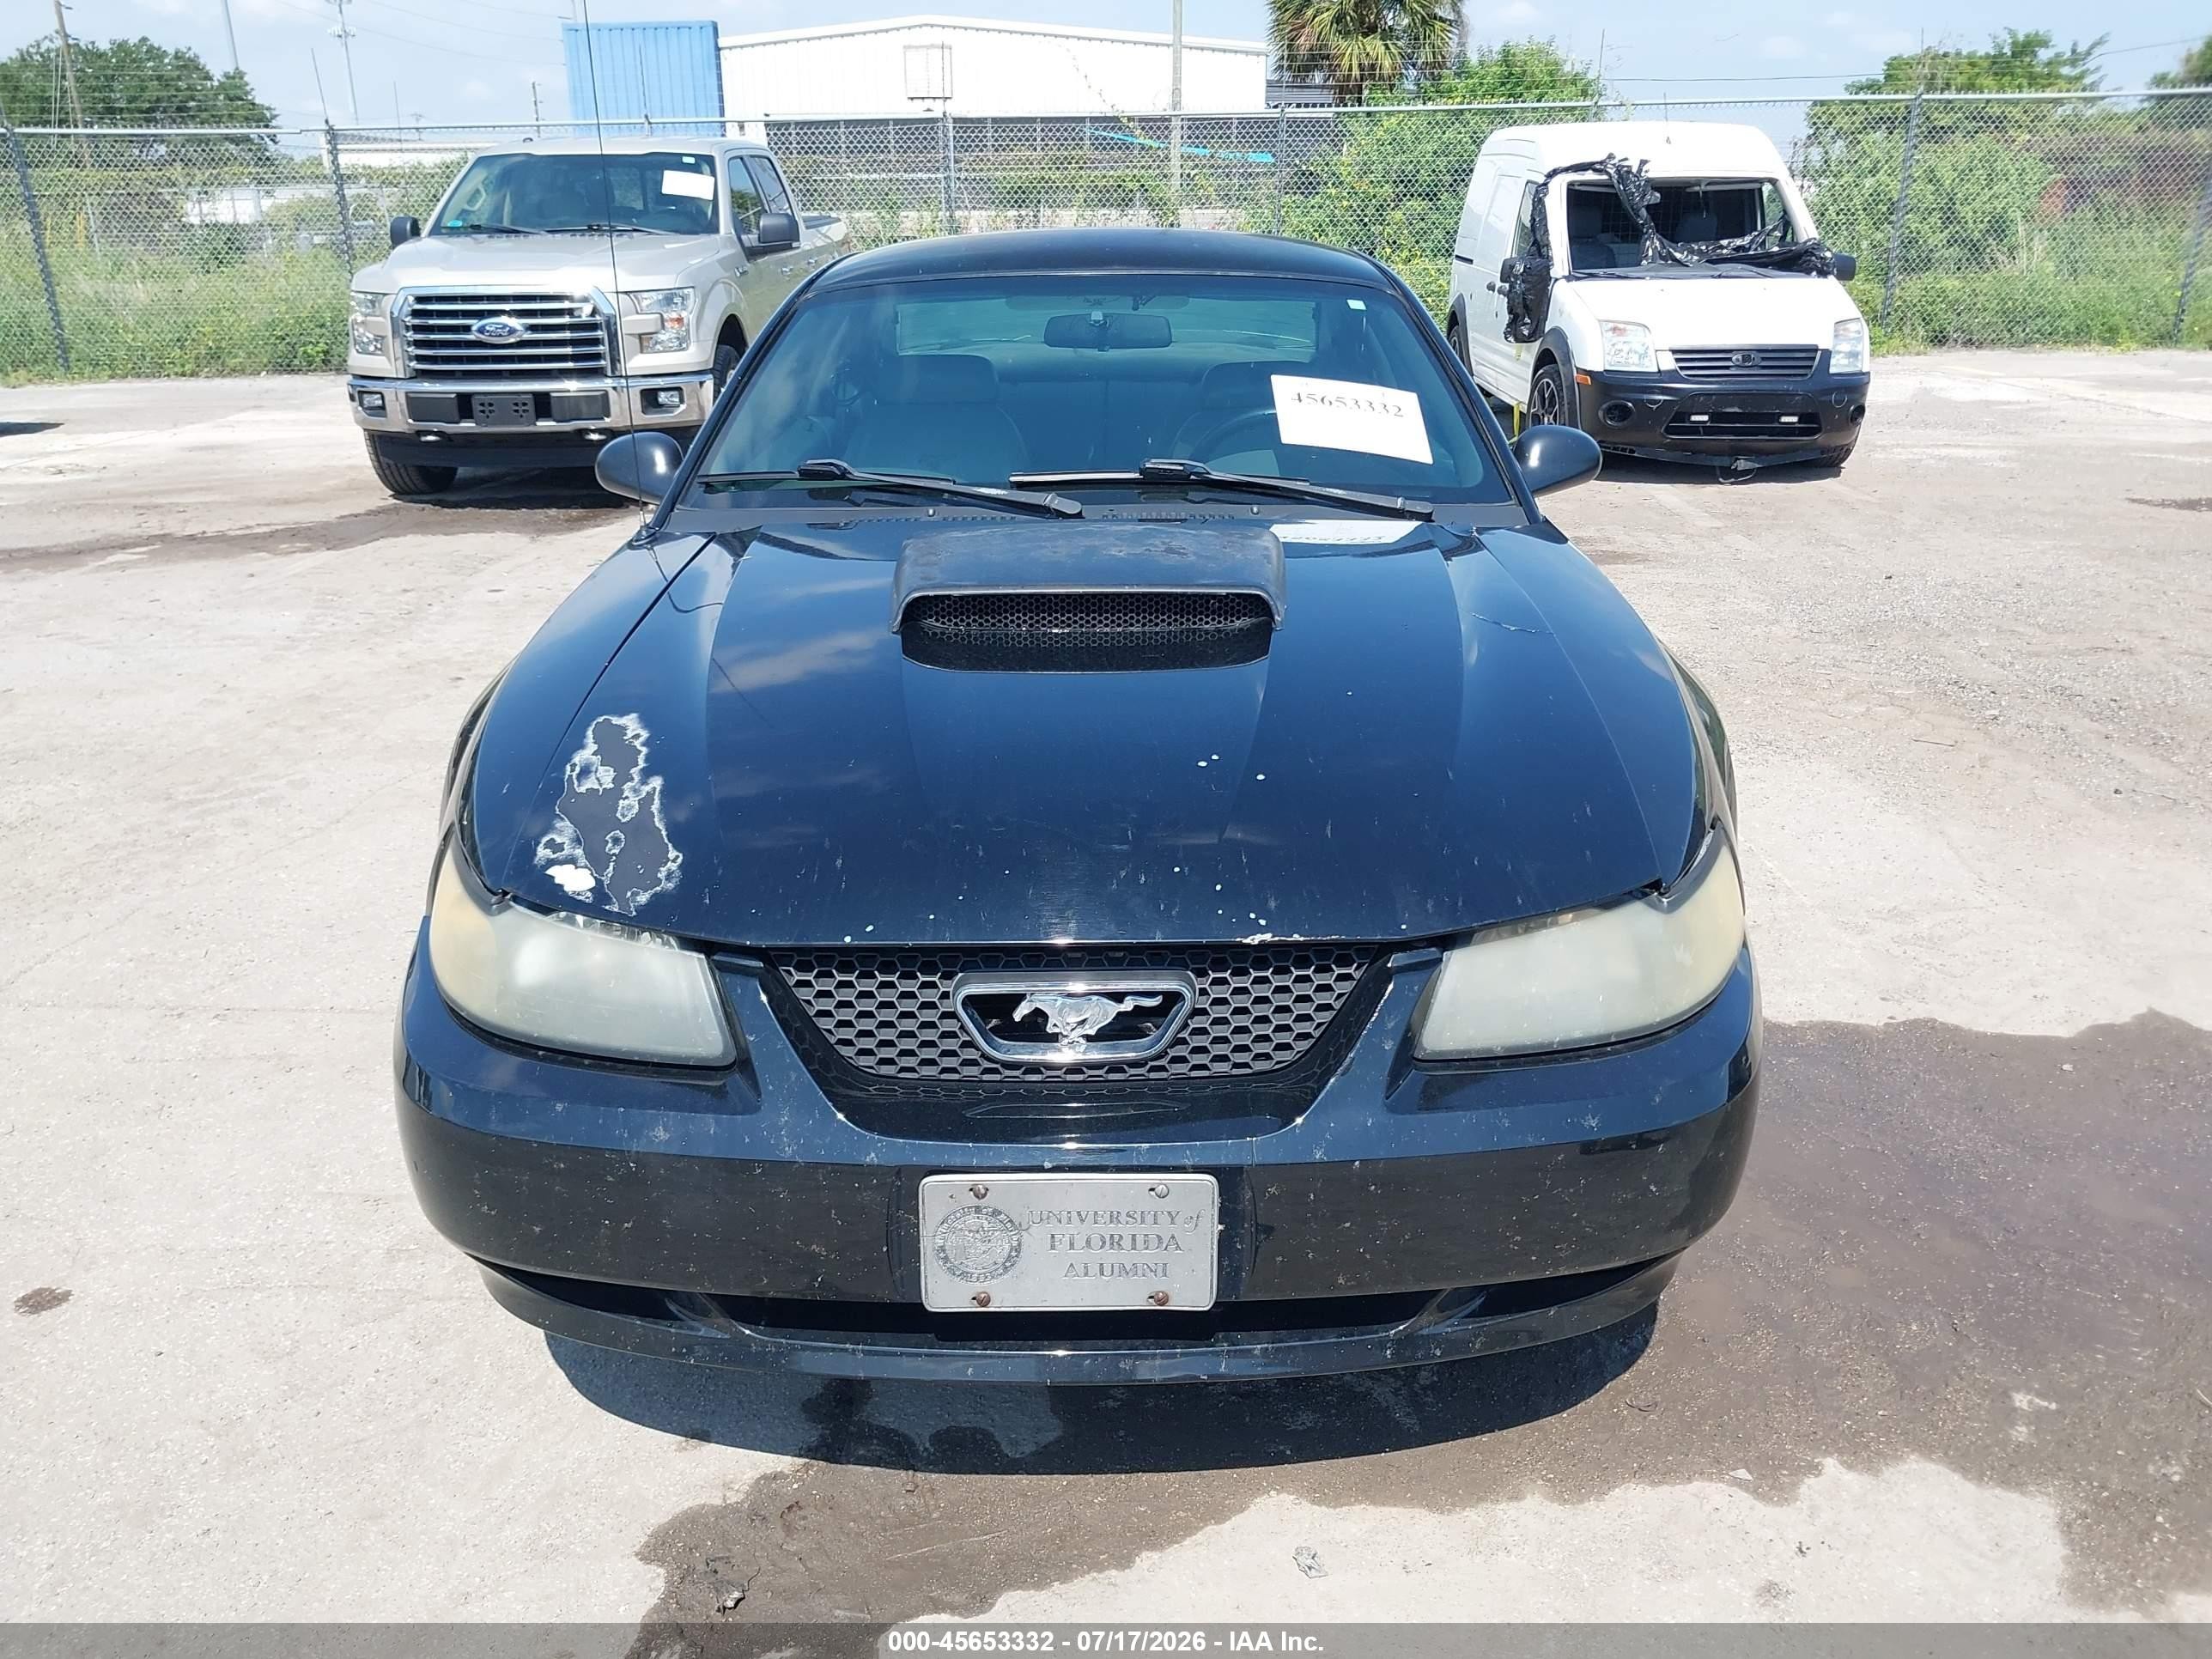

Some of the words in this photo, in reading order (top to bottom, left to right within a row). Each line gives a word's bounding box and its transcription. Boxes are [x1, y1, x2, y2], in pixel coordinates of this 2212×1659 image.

[484, 324, 509, 337] Ford
[1291, 392, 1404, 417] 45653332
[1026, 1209, 1182, 1228] UNIVERSITY
[1183, 1208, 1206, 1234] of
[1047, 1232, 1185, 1254] FLORIDA
[1061, 1261, 1171, 1280] ALUMNI
